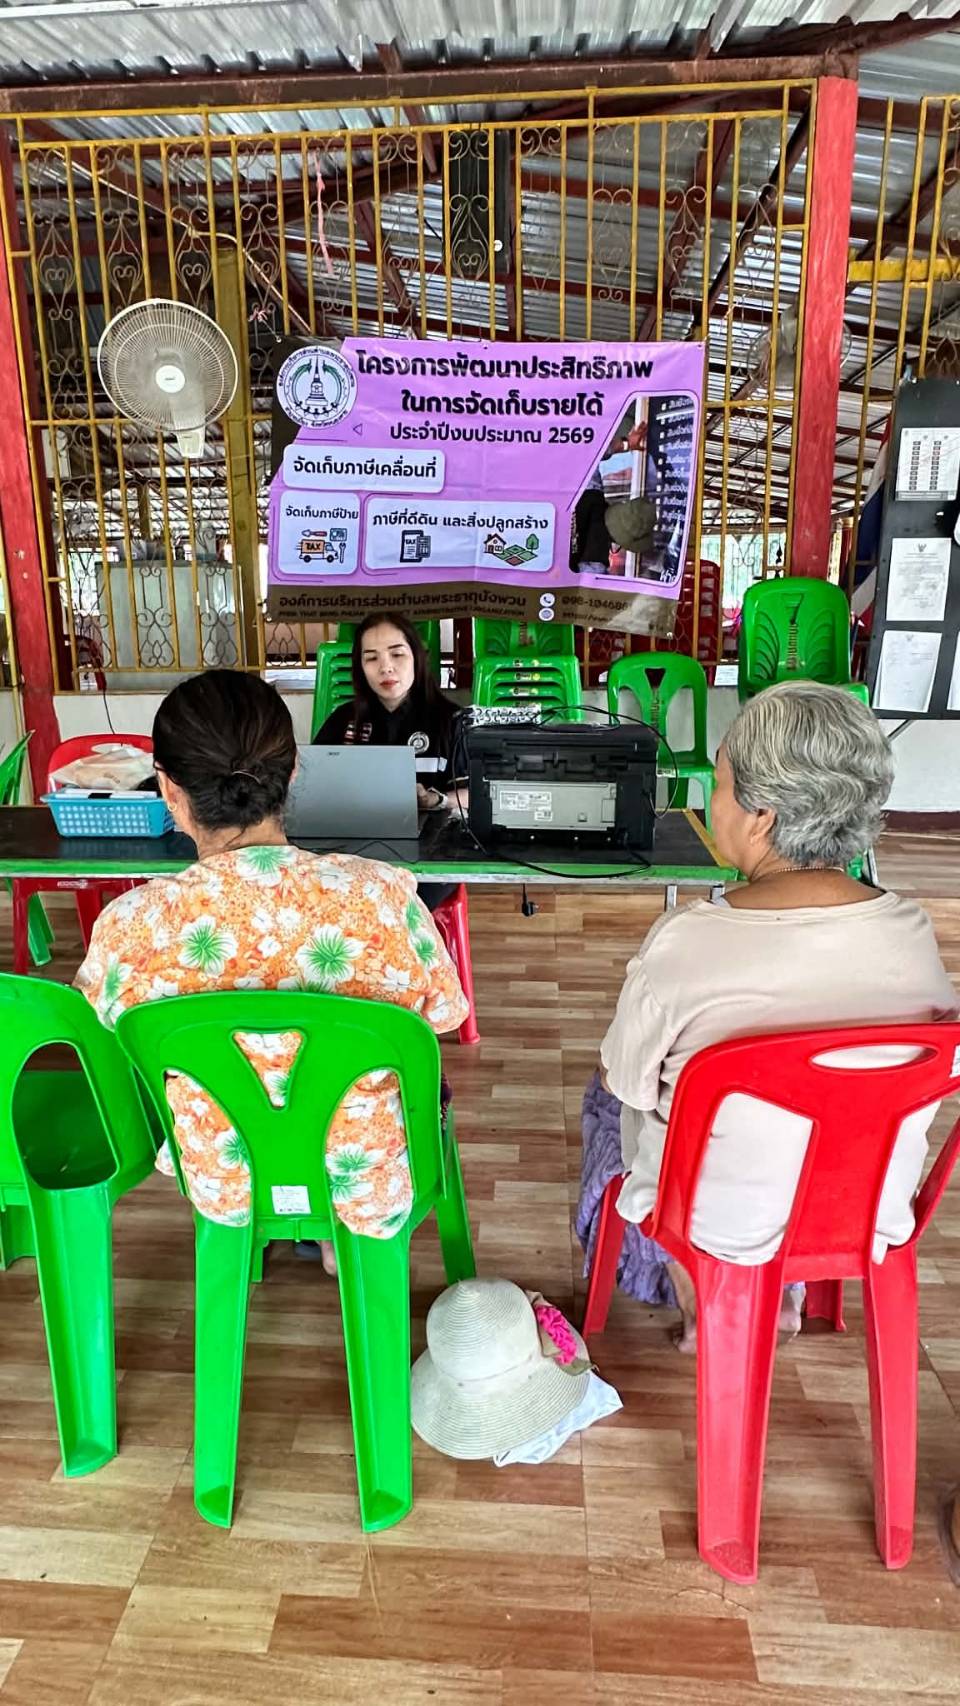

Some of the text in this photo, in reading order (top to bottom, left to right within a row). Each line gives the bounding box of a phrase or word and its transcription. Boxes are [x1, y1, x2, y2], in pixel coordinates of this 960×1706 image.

[356, 350, 654, 380] โครงการพัฒนาประสิทธิภาพ
[401, 389, 605, 417] ในการจัดเก็บรายได้
[390, 420, 595, 444] ประจำปีงบประมาณ 2569
[293, 455, 437, 478] จัดเก็บภาษีเคลื่อนที่
[285, 505, 359, 520] จัดเก็บภาษีป้าย
[443, 512, 549, 533] และสิ่งปลูกสร้าง
[304, 542, 321, 550] TAX
